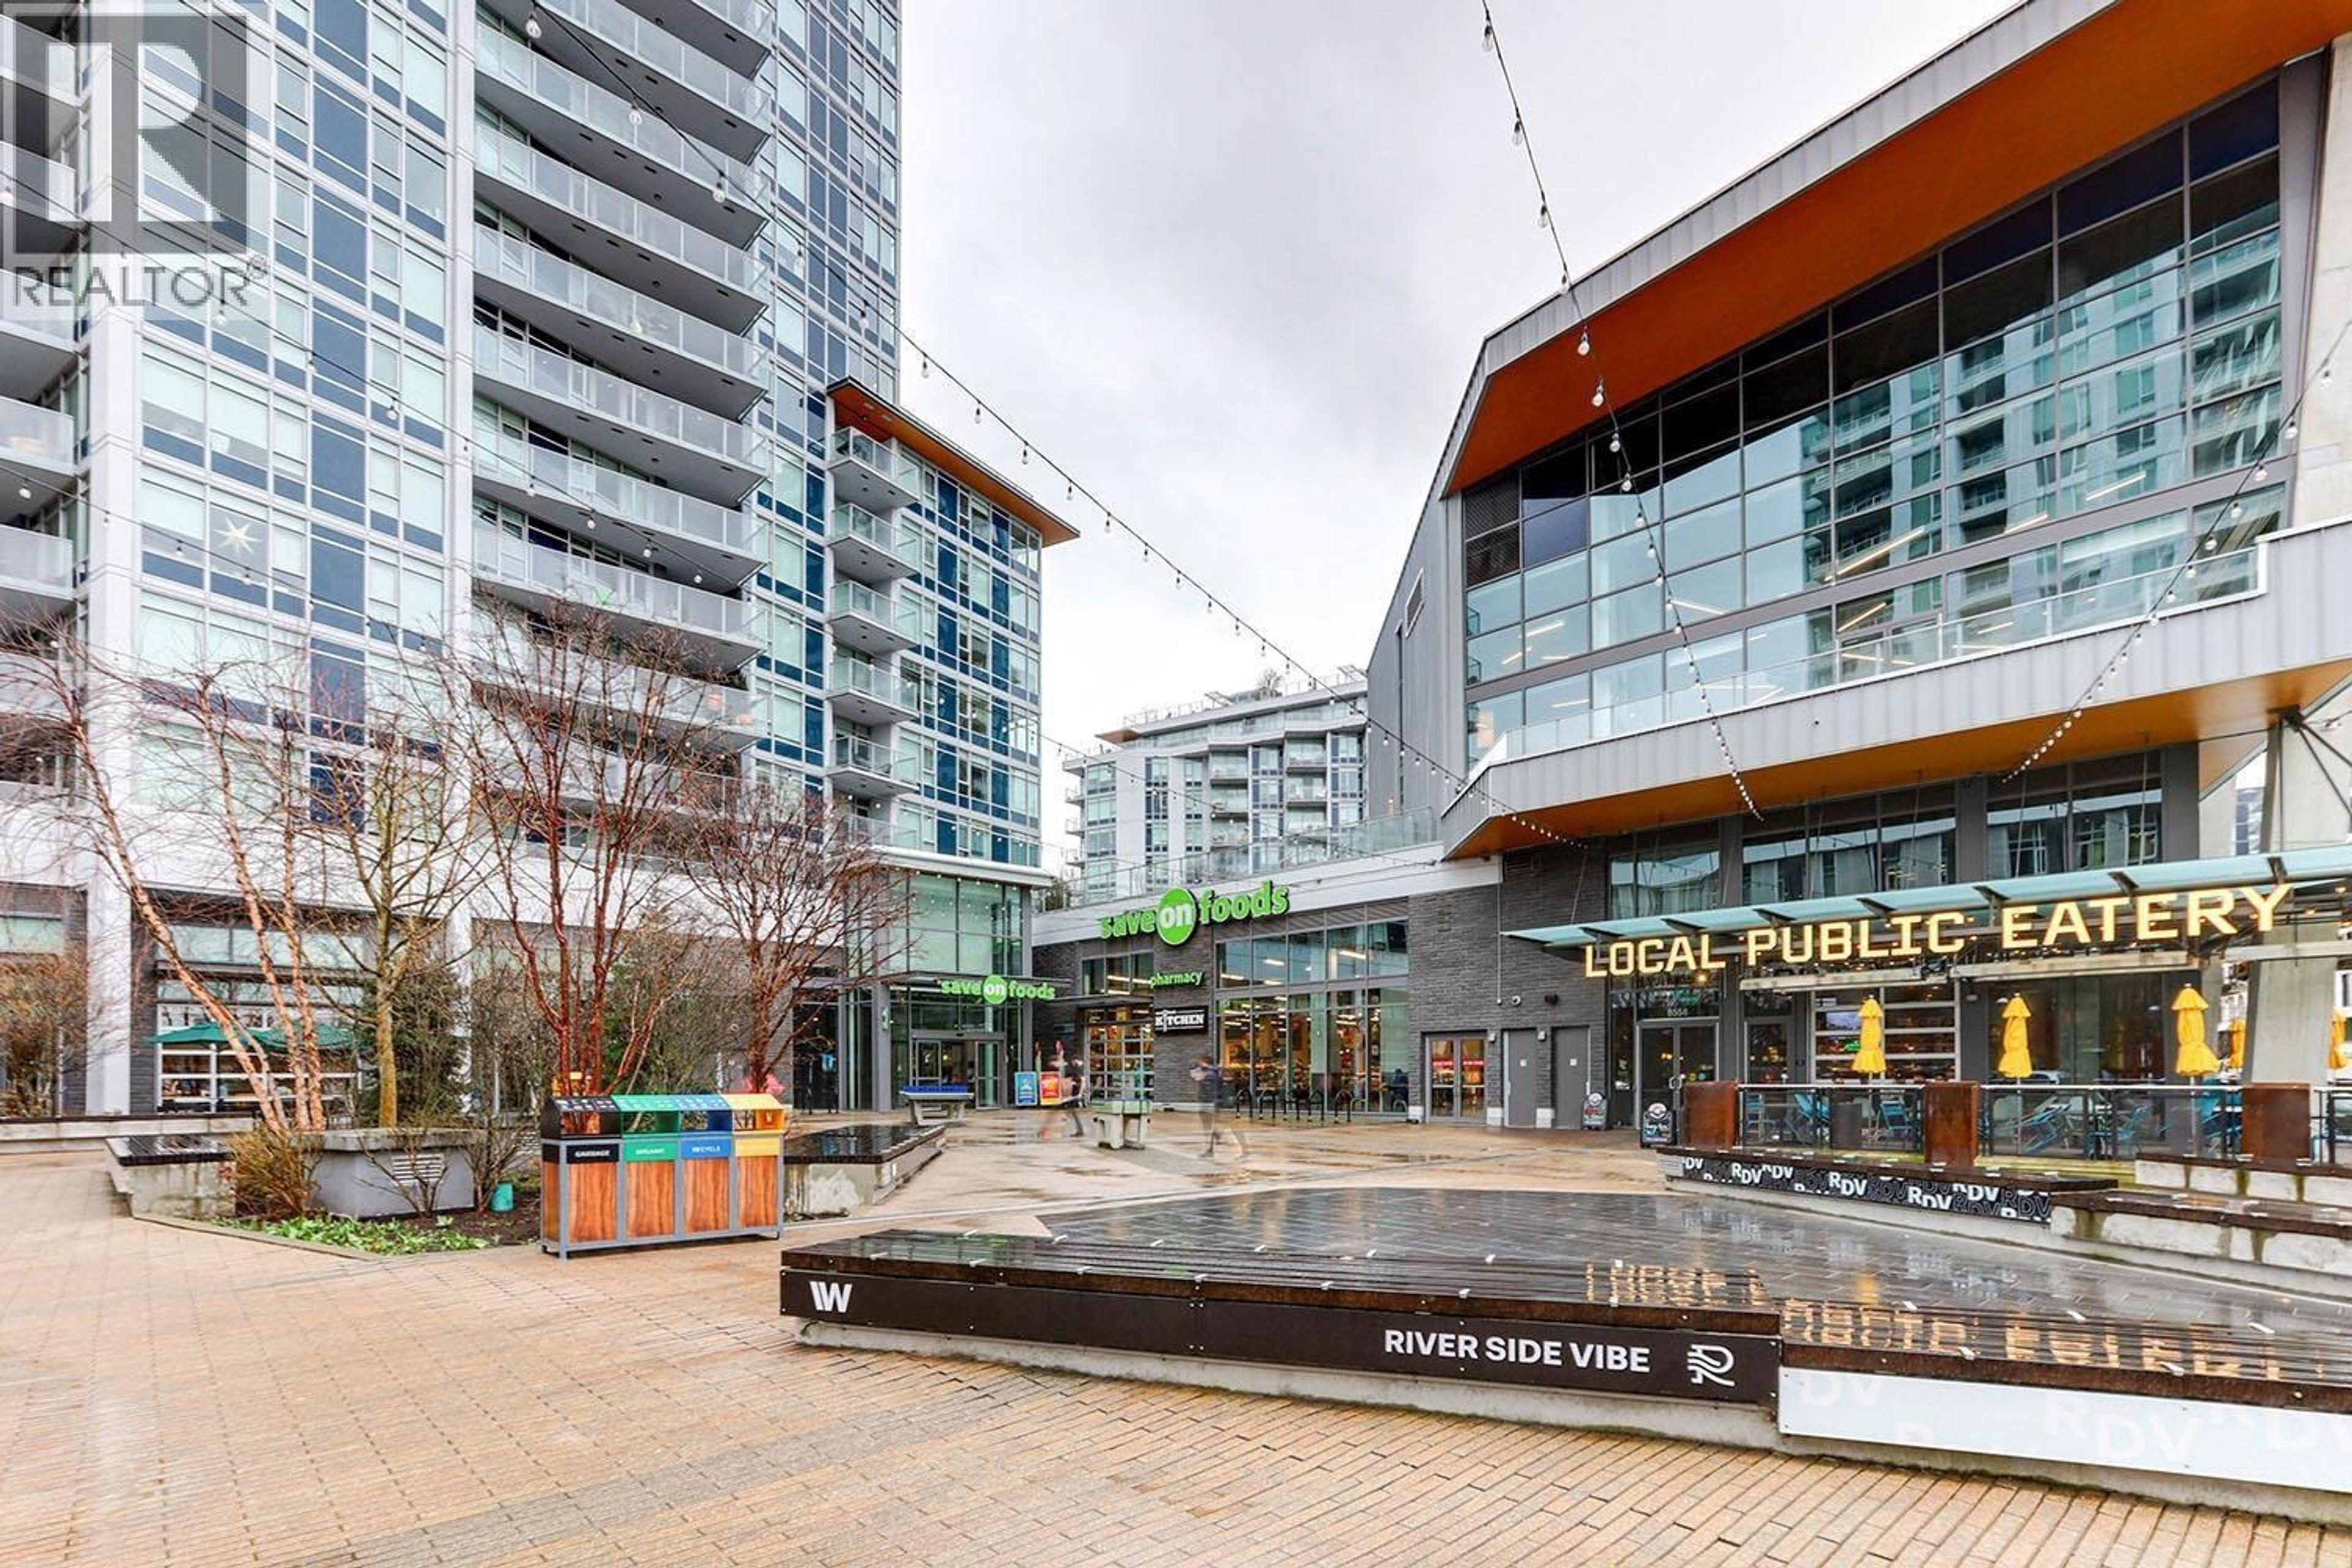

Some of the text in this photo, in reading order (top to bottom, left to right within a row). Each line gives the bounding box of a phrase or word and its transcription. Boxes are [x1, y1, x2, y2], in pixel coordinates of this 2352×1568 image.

[1101, 881, 1289, 938] save on foods
[1585, 883, 2293, 978] LOCAL PUBLIC EATERY
[941, 980, 1055, 1000] save on foods
[1151, 971, 1202, 989] pharmacy
[1155, 1012, 1205, 1029] KITCHEN
[1730, 1162, 1762, 1184] RDV
[1828, 1171, 1868, 1196] RDV
[1384, 1329, 1651, 1373] RIVER SIDE VIBE
